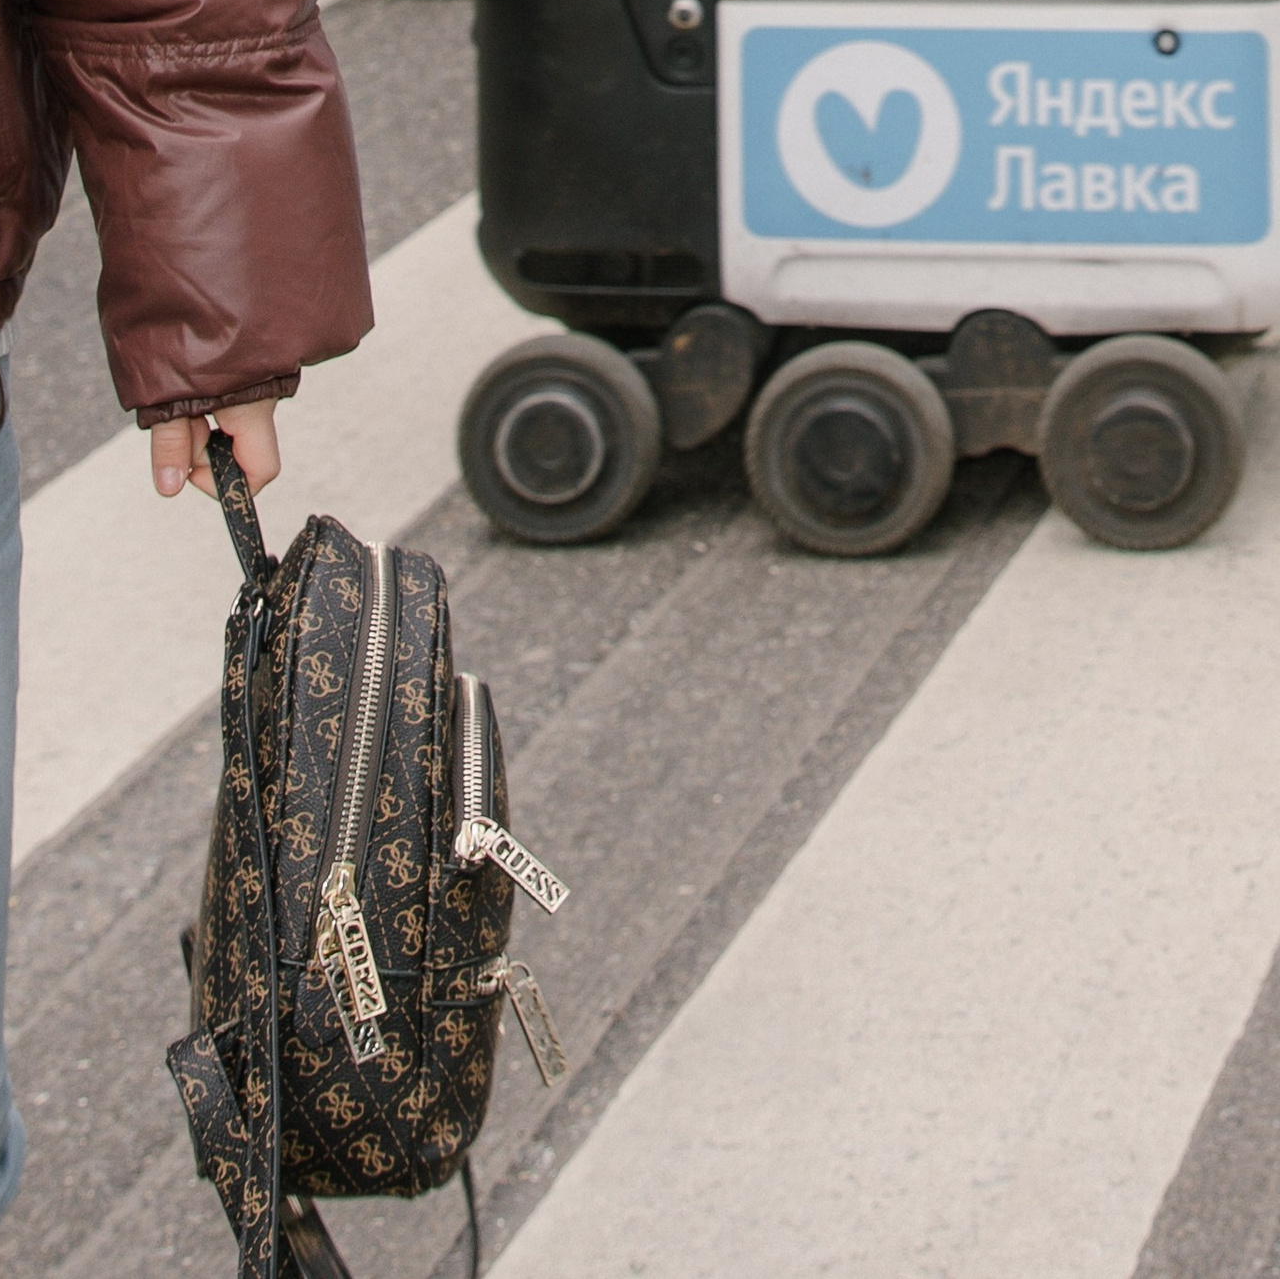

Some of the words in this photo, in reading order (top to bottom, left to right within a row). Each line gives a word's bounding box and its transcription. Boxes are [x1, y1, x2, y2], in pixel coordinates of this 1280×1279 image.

[986, 60, 1236, 138] Яндекс
[986, 145, 1201, 213] Лавка
[490, 832, 562, 908] GUESS
